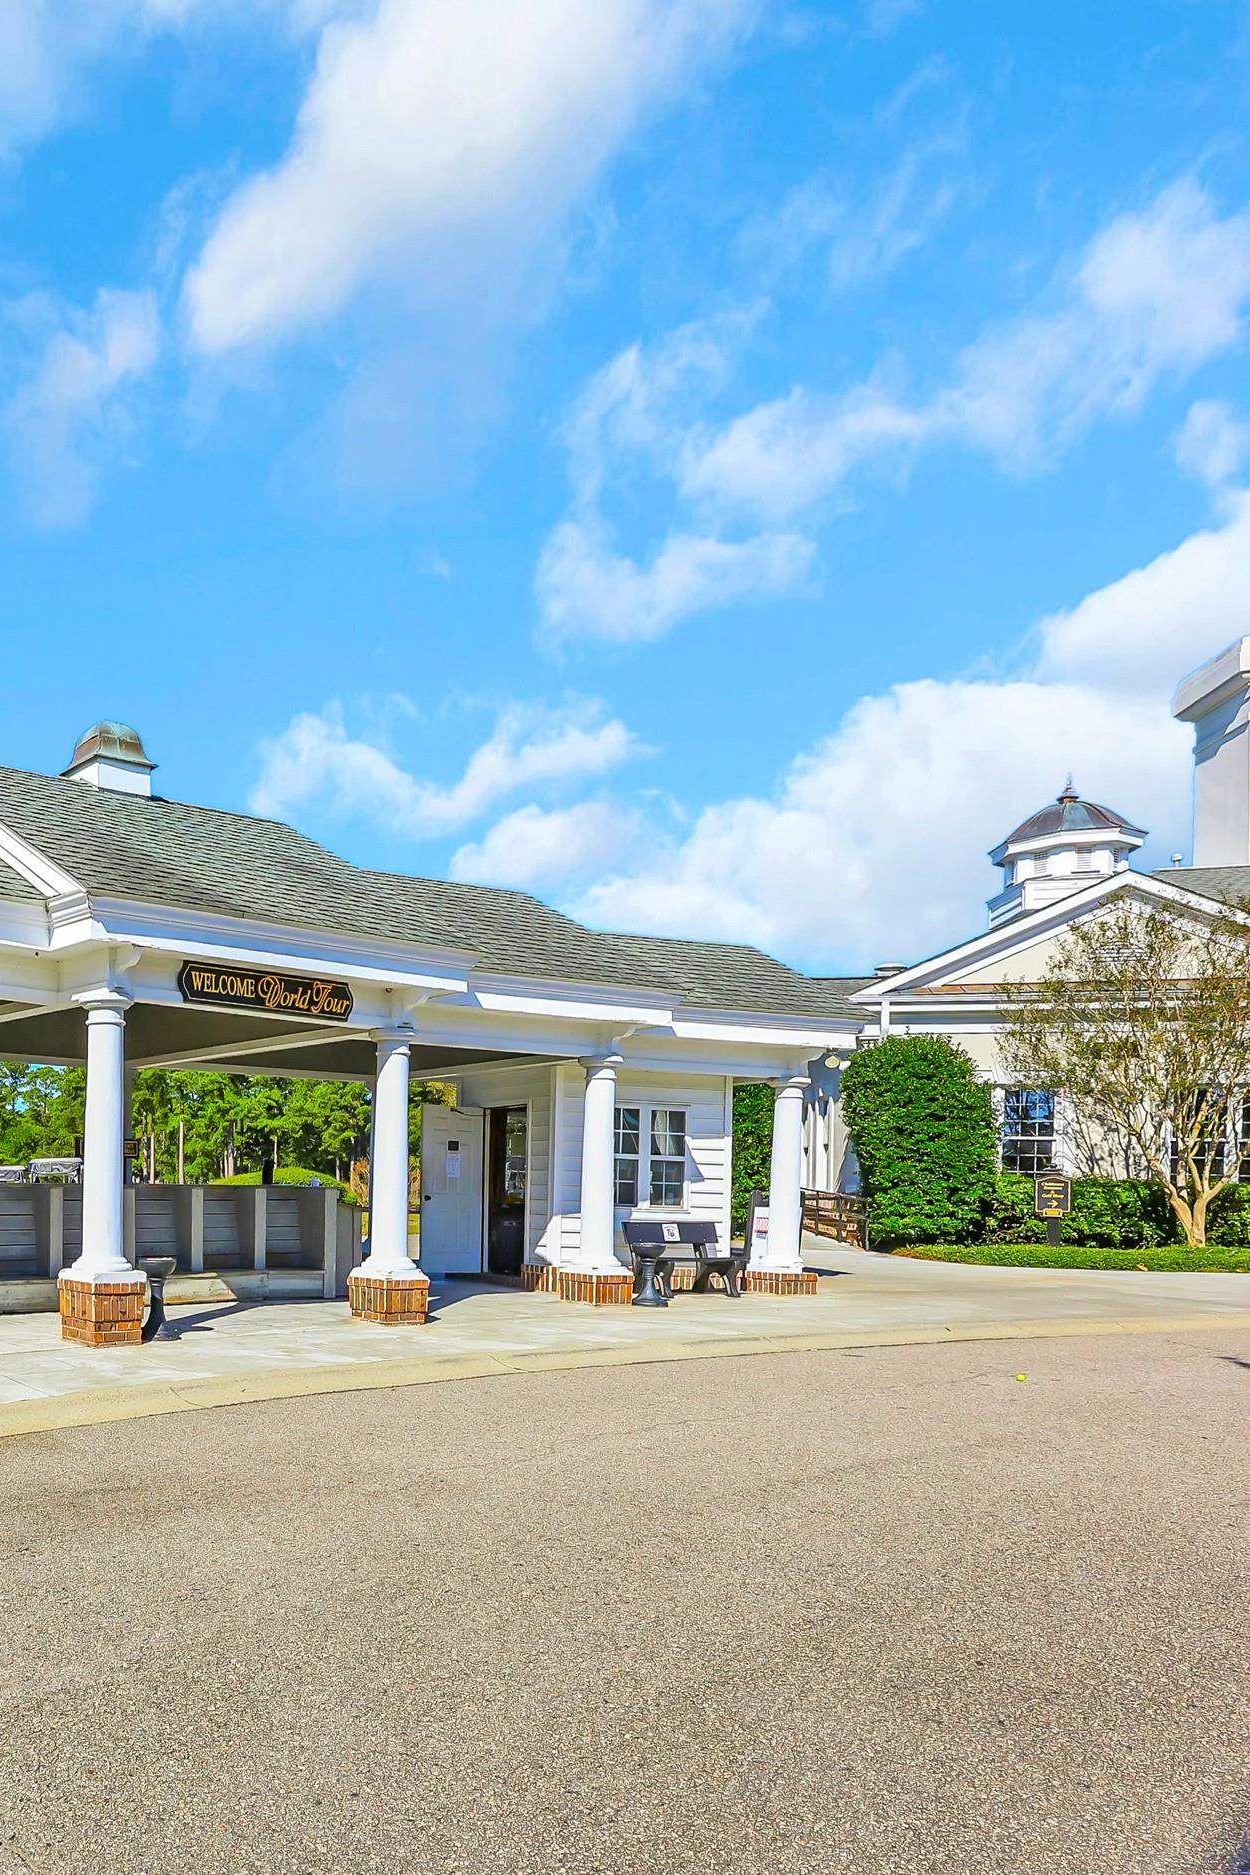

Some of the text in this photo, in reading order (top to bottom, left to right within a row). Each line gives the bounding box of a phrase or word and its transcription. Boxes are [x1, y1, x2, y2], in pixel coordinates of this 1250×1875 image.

[191, 971, 350, 1014] WELCOME World Tour
